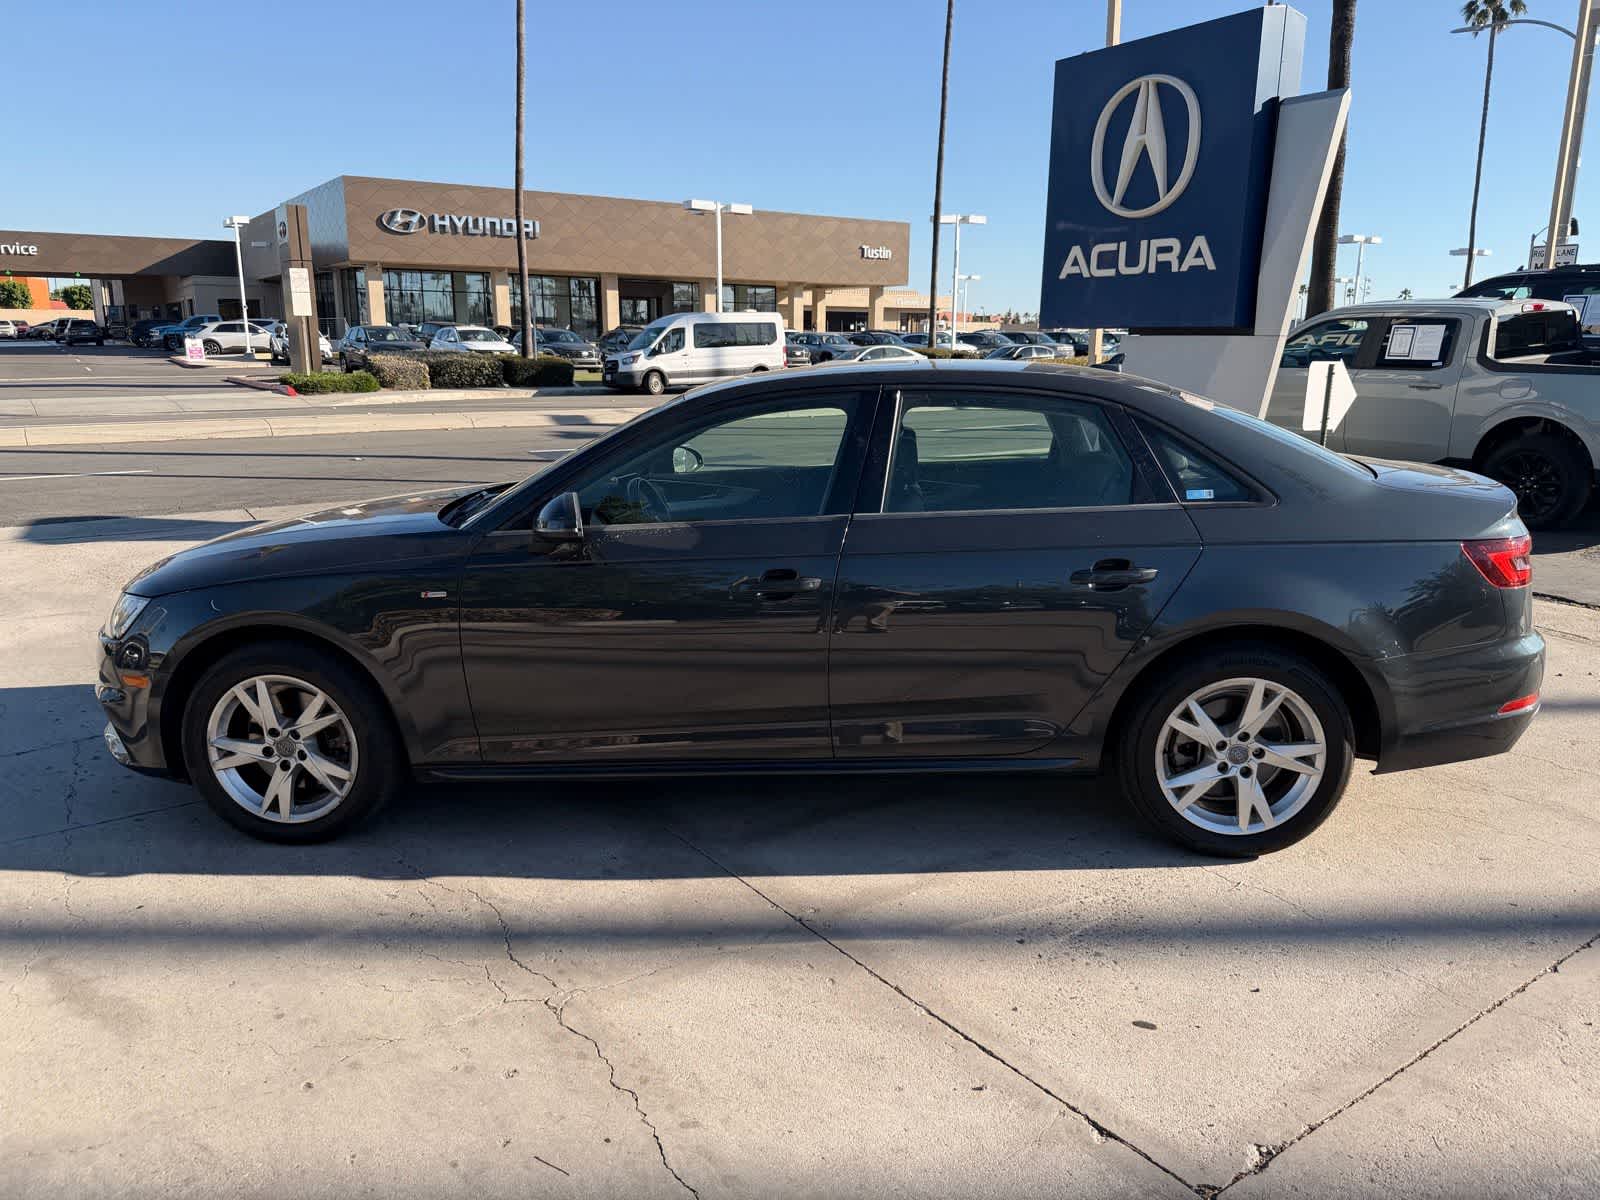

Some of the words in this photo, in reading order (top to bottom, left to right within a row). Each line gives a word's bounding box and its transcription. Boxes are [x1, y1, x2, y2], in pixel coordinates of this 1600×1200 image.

[430, 213, 540, 239] HYUNDAI
[0, 242, 38, 255] rvice
[862, 245, 892, 259] Tustin
[1556, 248, 1576, 257] LANE
[1058, 235, 1217, 280] ACURA
